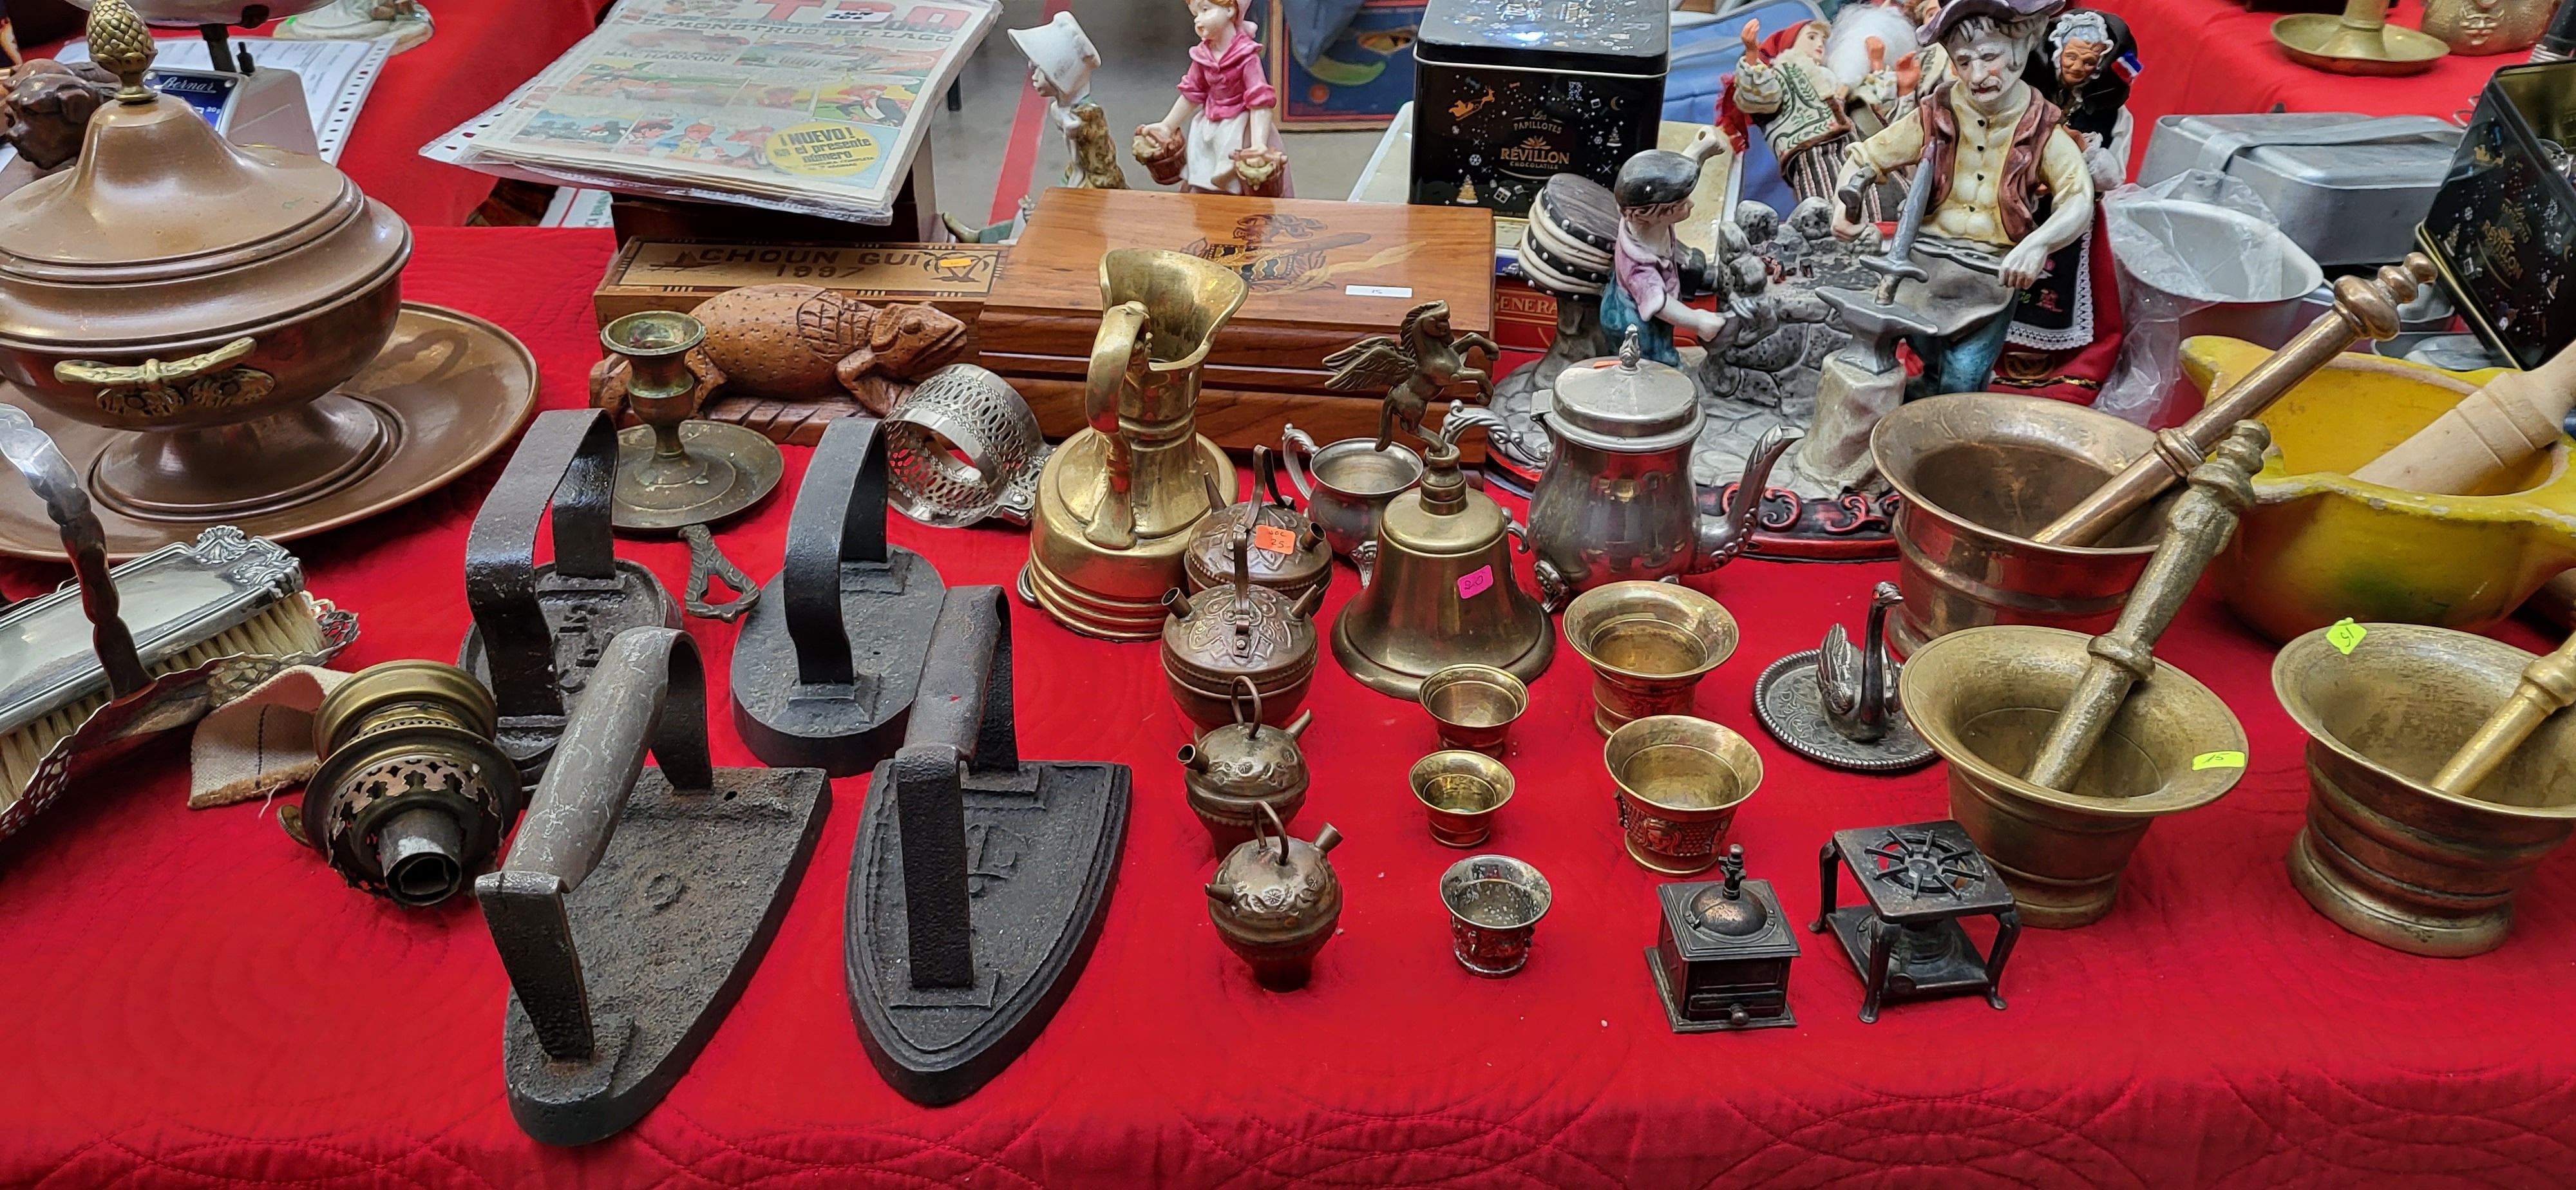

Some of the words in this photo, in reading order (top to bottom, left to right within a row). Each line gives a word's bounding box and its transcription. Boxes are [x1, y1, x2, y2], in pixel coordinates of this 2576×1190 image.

[670, 21, 820, 35] MONSTRUO
[825, 28, 876, 37] DEL
[158, 76, 217, 93] Bernar
[1513, 121, 1563, 134] PAPILLOTES
[811, 137, 872, 154] presente
[1499, 146, 1571, 165] RÉVILLON
[1509, 160, 1558, 170] CHOCOLATIER
[775, 264, 865, 278] 1997
[2201, 753, 2231, 764] 15
